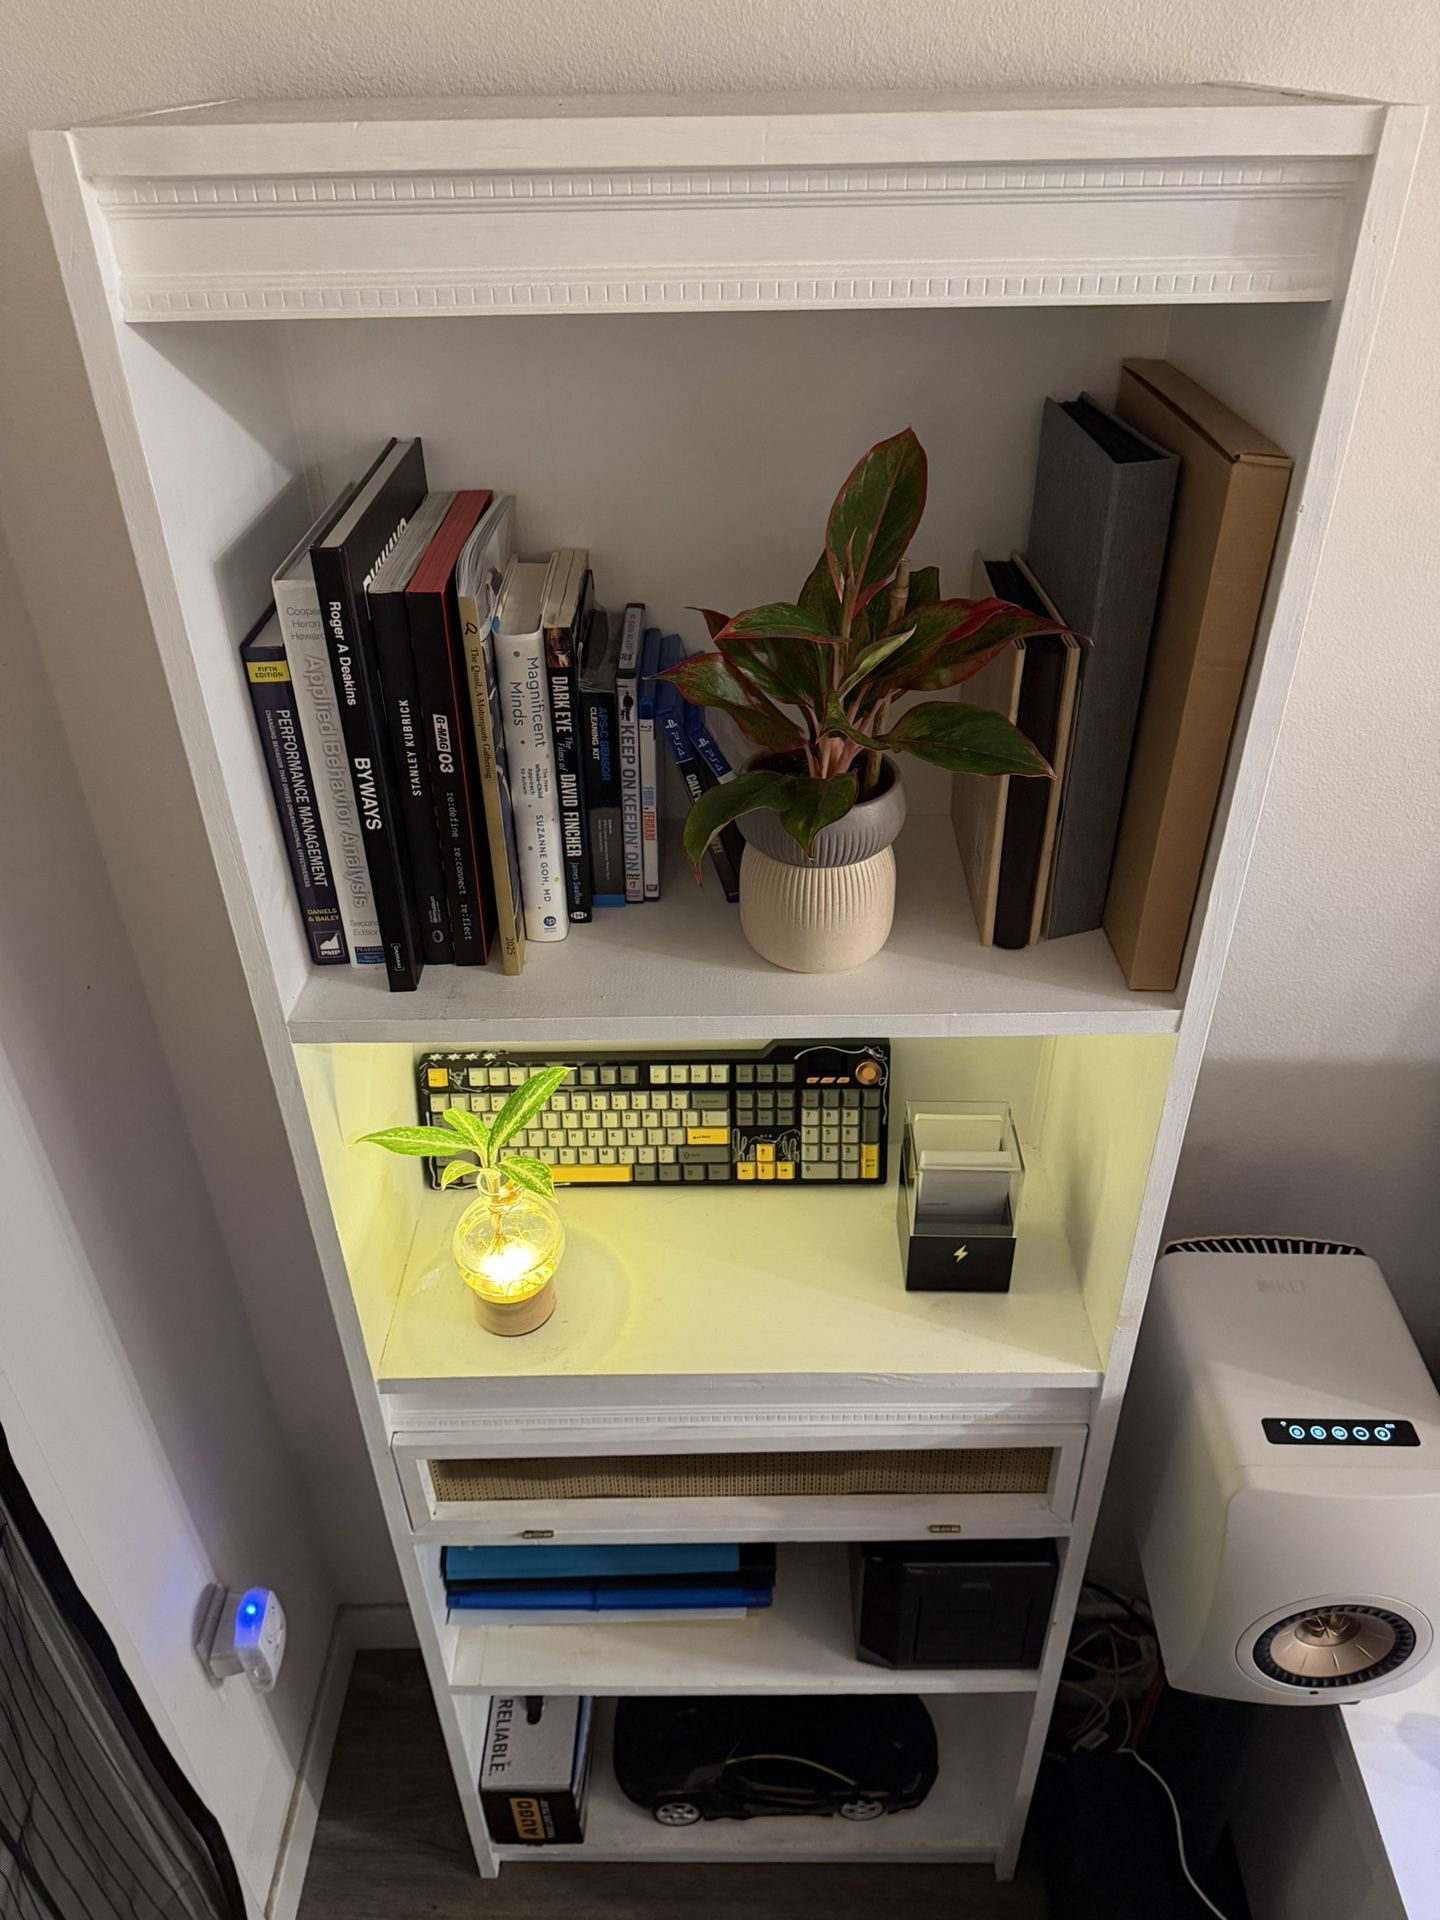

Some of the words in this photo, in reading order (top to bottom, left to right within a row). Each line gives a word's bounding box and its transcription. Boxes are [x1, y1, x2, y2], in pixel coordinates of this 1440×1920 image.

[329, 601, 345, 641] Roger
[336, 644, 349, 653] A
[339, 657, 357, 706] Deakins
[552, 676, 571, 709] DARK
[470, 648, 479, 661] The
[476, 698, 488, 742] Motorsports
[483, 743, 492, 779] Gathering
[509, 681, 528, 726] Minds
[526, 657, 547, 748] Magnificent
[265, 709, 277, 740] CHANGING
[398, 700, 415, 747] KUBRICK
[435, 716, 449, 751] G-MAG
[554, 711, 573, 733] EYE
[589, 706, 600, 746] CLEANING
[598, 707, 609, 738] APS-C
[272, 741, 284, 769] BEHAVIOR
[557, 742, 566, 762] Films
[564, 736, 574, 750] The
[592, 748, 600, 761] KIT
[620, 725, 636, 765] KEEP
[671, 732, 686, 756] PS4
[278, 769, 287, 782] THAT
[406, 751, 422, 796] STANLEY
[438, 753, 454, 774] 03
[558, 762, 568, 772] of
[600, 740, 611, 781] SENSOR
[705, 749, 724, 772] PS4
[282, 783, 292, 803] DRIVES
[303, 654, 339, 737] Applied
[323, 741, 354, 828] Behavior
[341, 831, 371, 909] Analysis
[354, 757, 382, 830] BYWAYS
[560, 774, 578, 807] DAVID
[622, 768, 637, 790] ON
[686, 774, 701, 797] CALL
[276, 709, 310, 803] PERFORMANCE
[297, 806, 328, 887] MANAGEMENT
[287, 804, 302, 848] ORGANIZATIONAL
[535, 814, 548, 859] SUZANNE
[563, 811, 582, 857] FINCHER
[623, 794, 638, 849] KEEPIN'
[297, 849, 311, 888] EFFECTIVENESS
[446, 792, 459, 838] re:define
[453, 847, 467, 895] re:connect
[460, 904, 473, 940] re:flect
[540, 862, 549, 886] GOH,
[570, 862, 580, 880] James
[624, 852, 639, 871] ON
[543, 889, 552, 902] MD
[573, 881, 583, 905] Swallow
[315, 914, 340, 922] BAILEY
[505, 936, 516, 956] 2025
[488, 1699, 514, 1776] RELIABLE.
